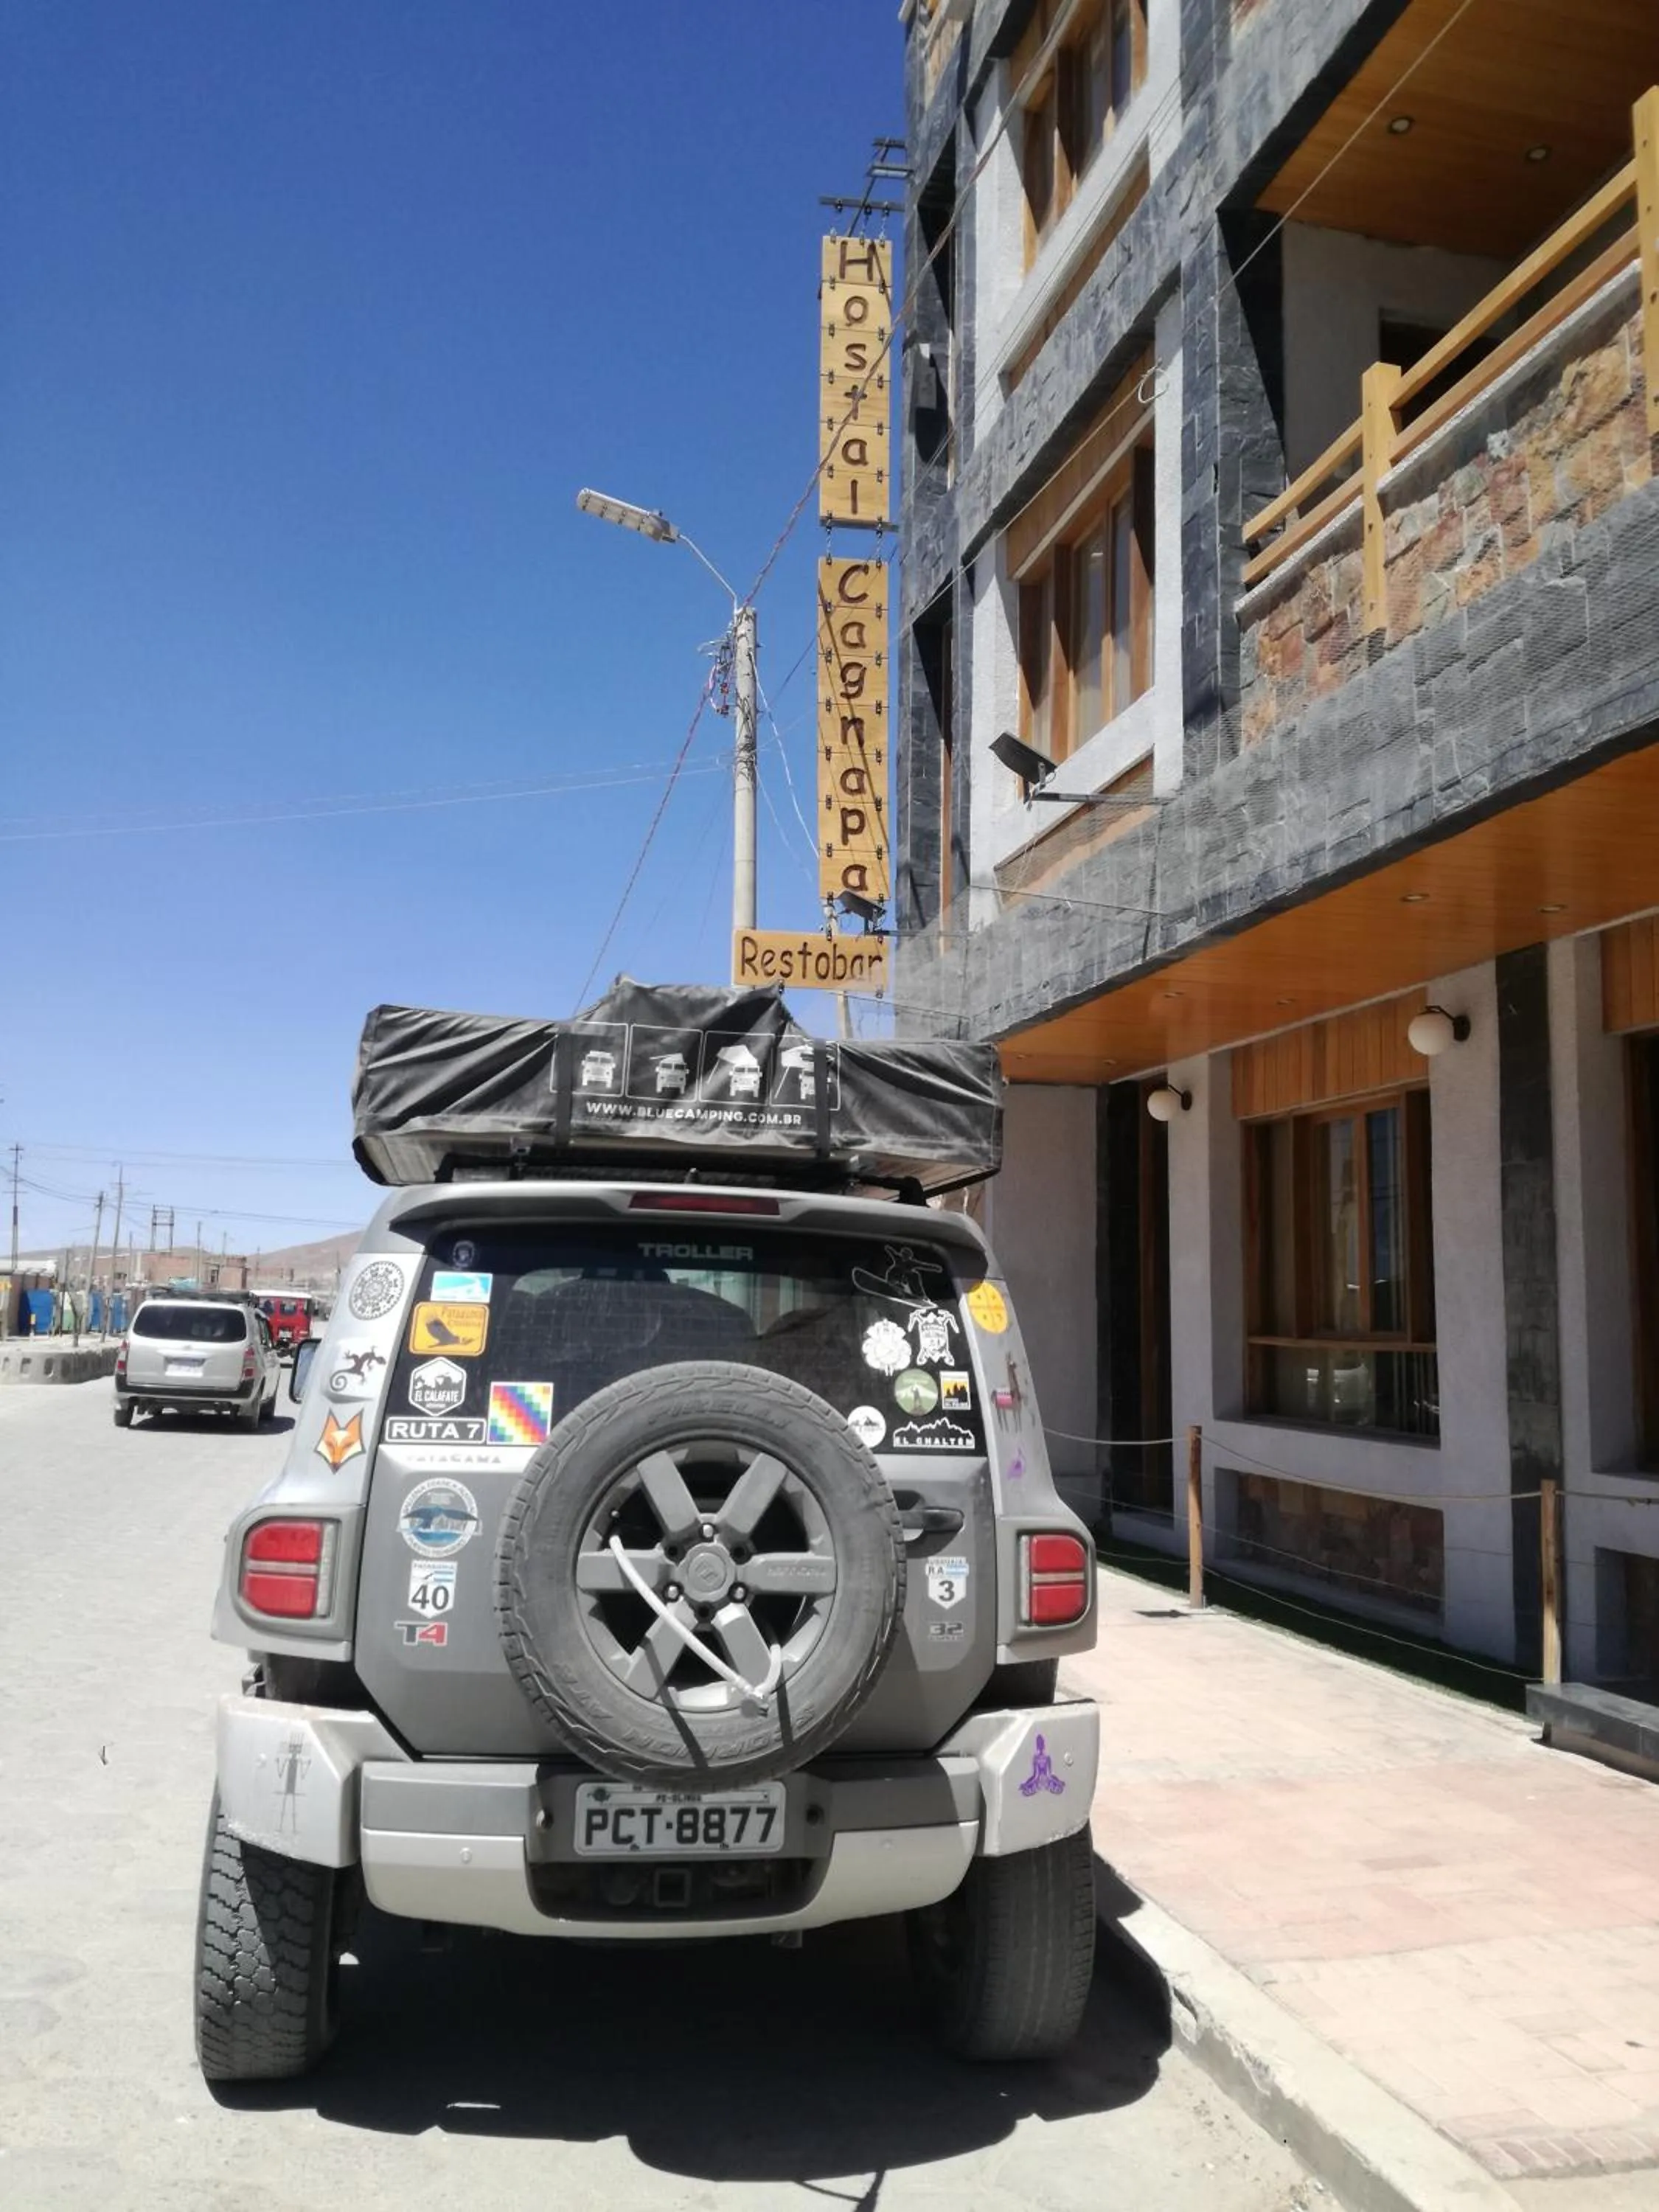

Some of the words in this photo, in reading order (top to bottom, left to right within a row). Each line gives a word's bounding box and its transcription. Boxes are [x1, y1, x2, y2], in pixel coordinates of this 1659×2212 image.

[839, 240, 874, 514] Hostal
[838, 564, 869, 892] Cagnapa
[740, 935, 883, 981] Restobar
[586, 1102, 801, 1125] WWW.BLUECAMPING.COM.BR
[638, 1242, 754, 1261] TROLLER
[414, 1390, 422, 1402] EL
[424, 1390, 459, 1403] CALAFATE
[391, 1422, 459, 1439] RUTA
[467, 1423, 481, 1439] 7
[411, 1584, 449, 1610] 40
[939, 1580, 956, 1602] 3
[394, 1621, 448, 1646] T4
